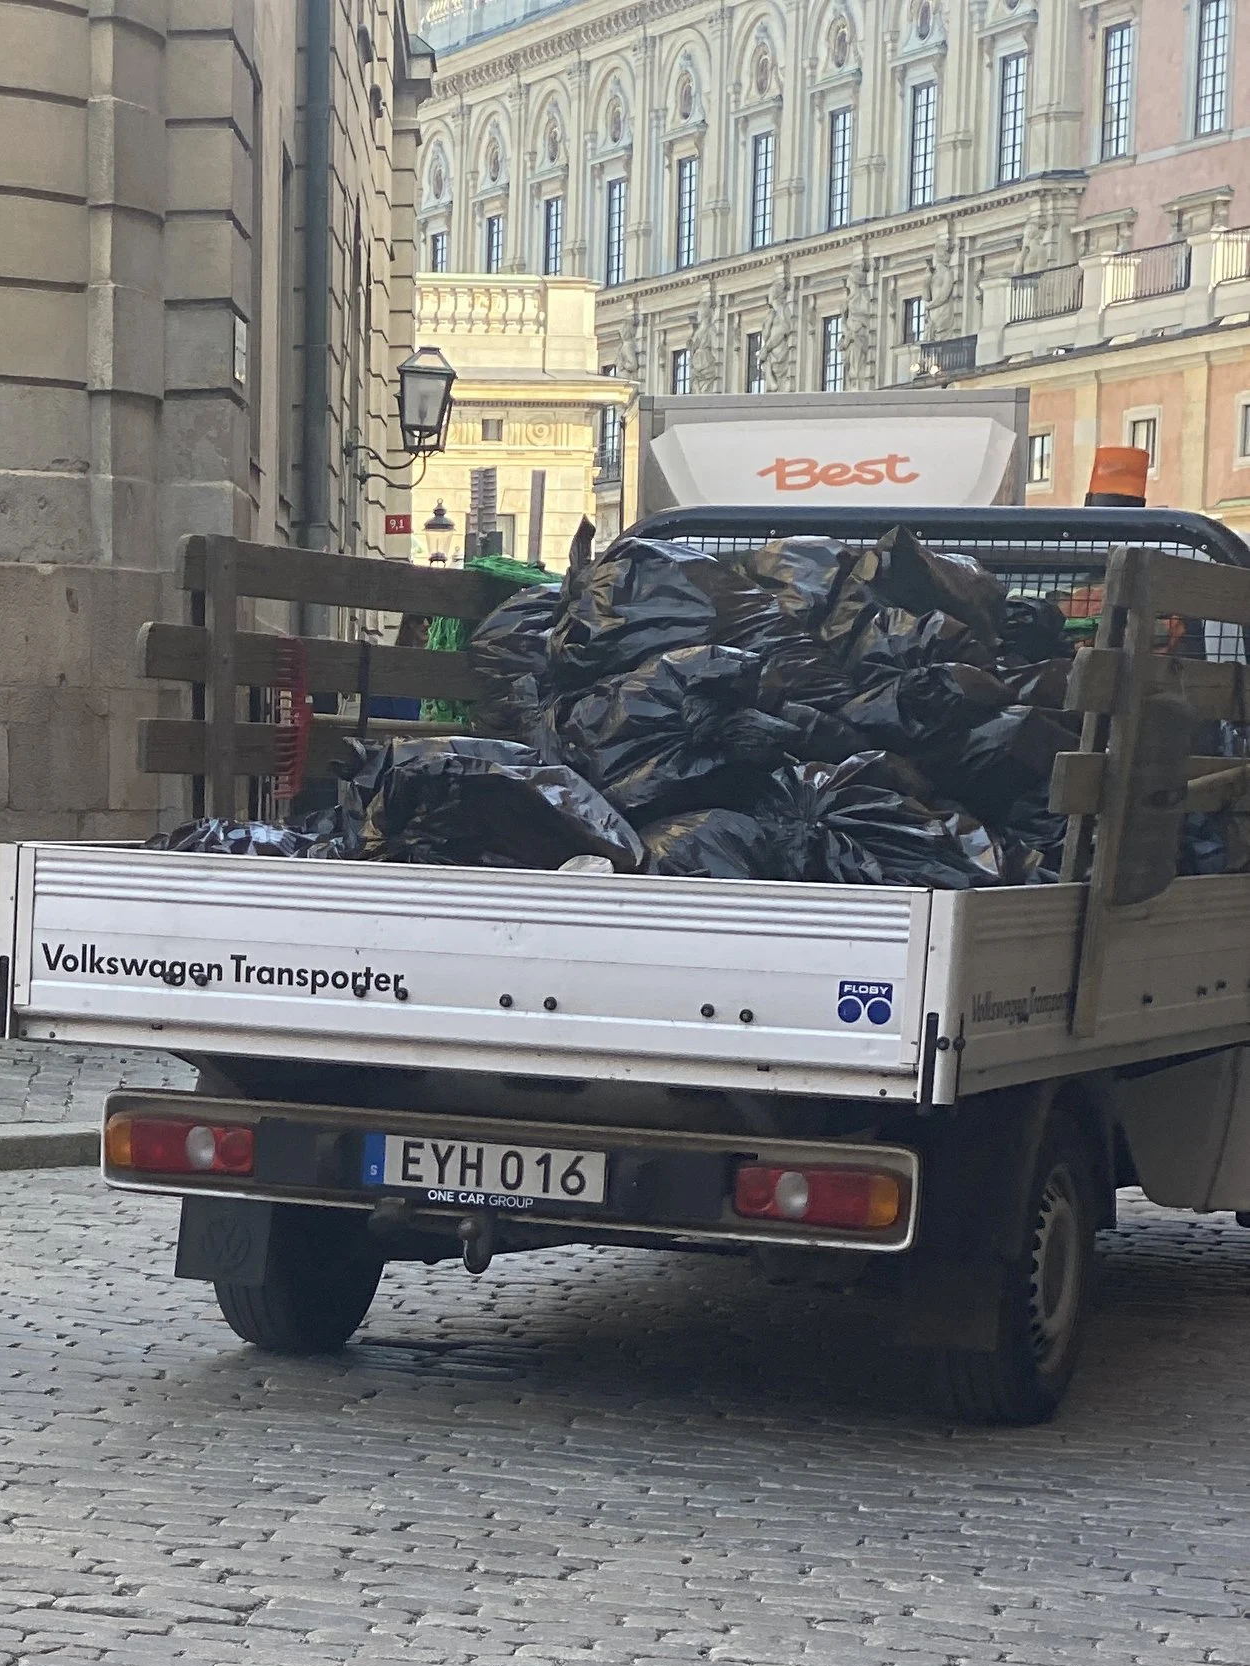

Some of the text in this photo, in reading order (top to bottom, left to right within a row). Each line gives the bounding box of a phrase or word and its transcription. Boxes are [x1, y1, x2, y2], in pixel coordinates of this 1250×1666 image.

[756, 454, 920, 491] Best
[389, 518, 405, 531] 9,1
[41, 943, 404, 994] Volkswagen Transporter
[844, 984, 889, 995] FLOBY
[369, 1164, 378, 1176] S
[401, 1140, 586, 1196] EYH 016
[427, 1189, 534, 1209] ONE CAR GROUP
